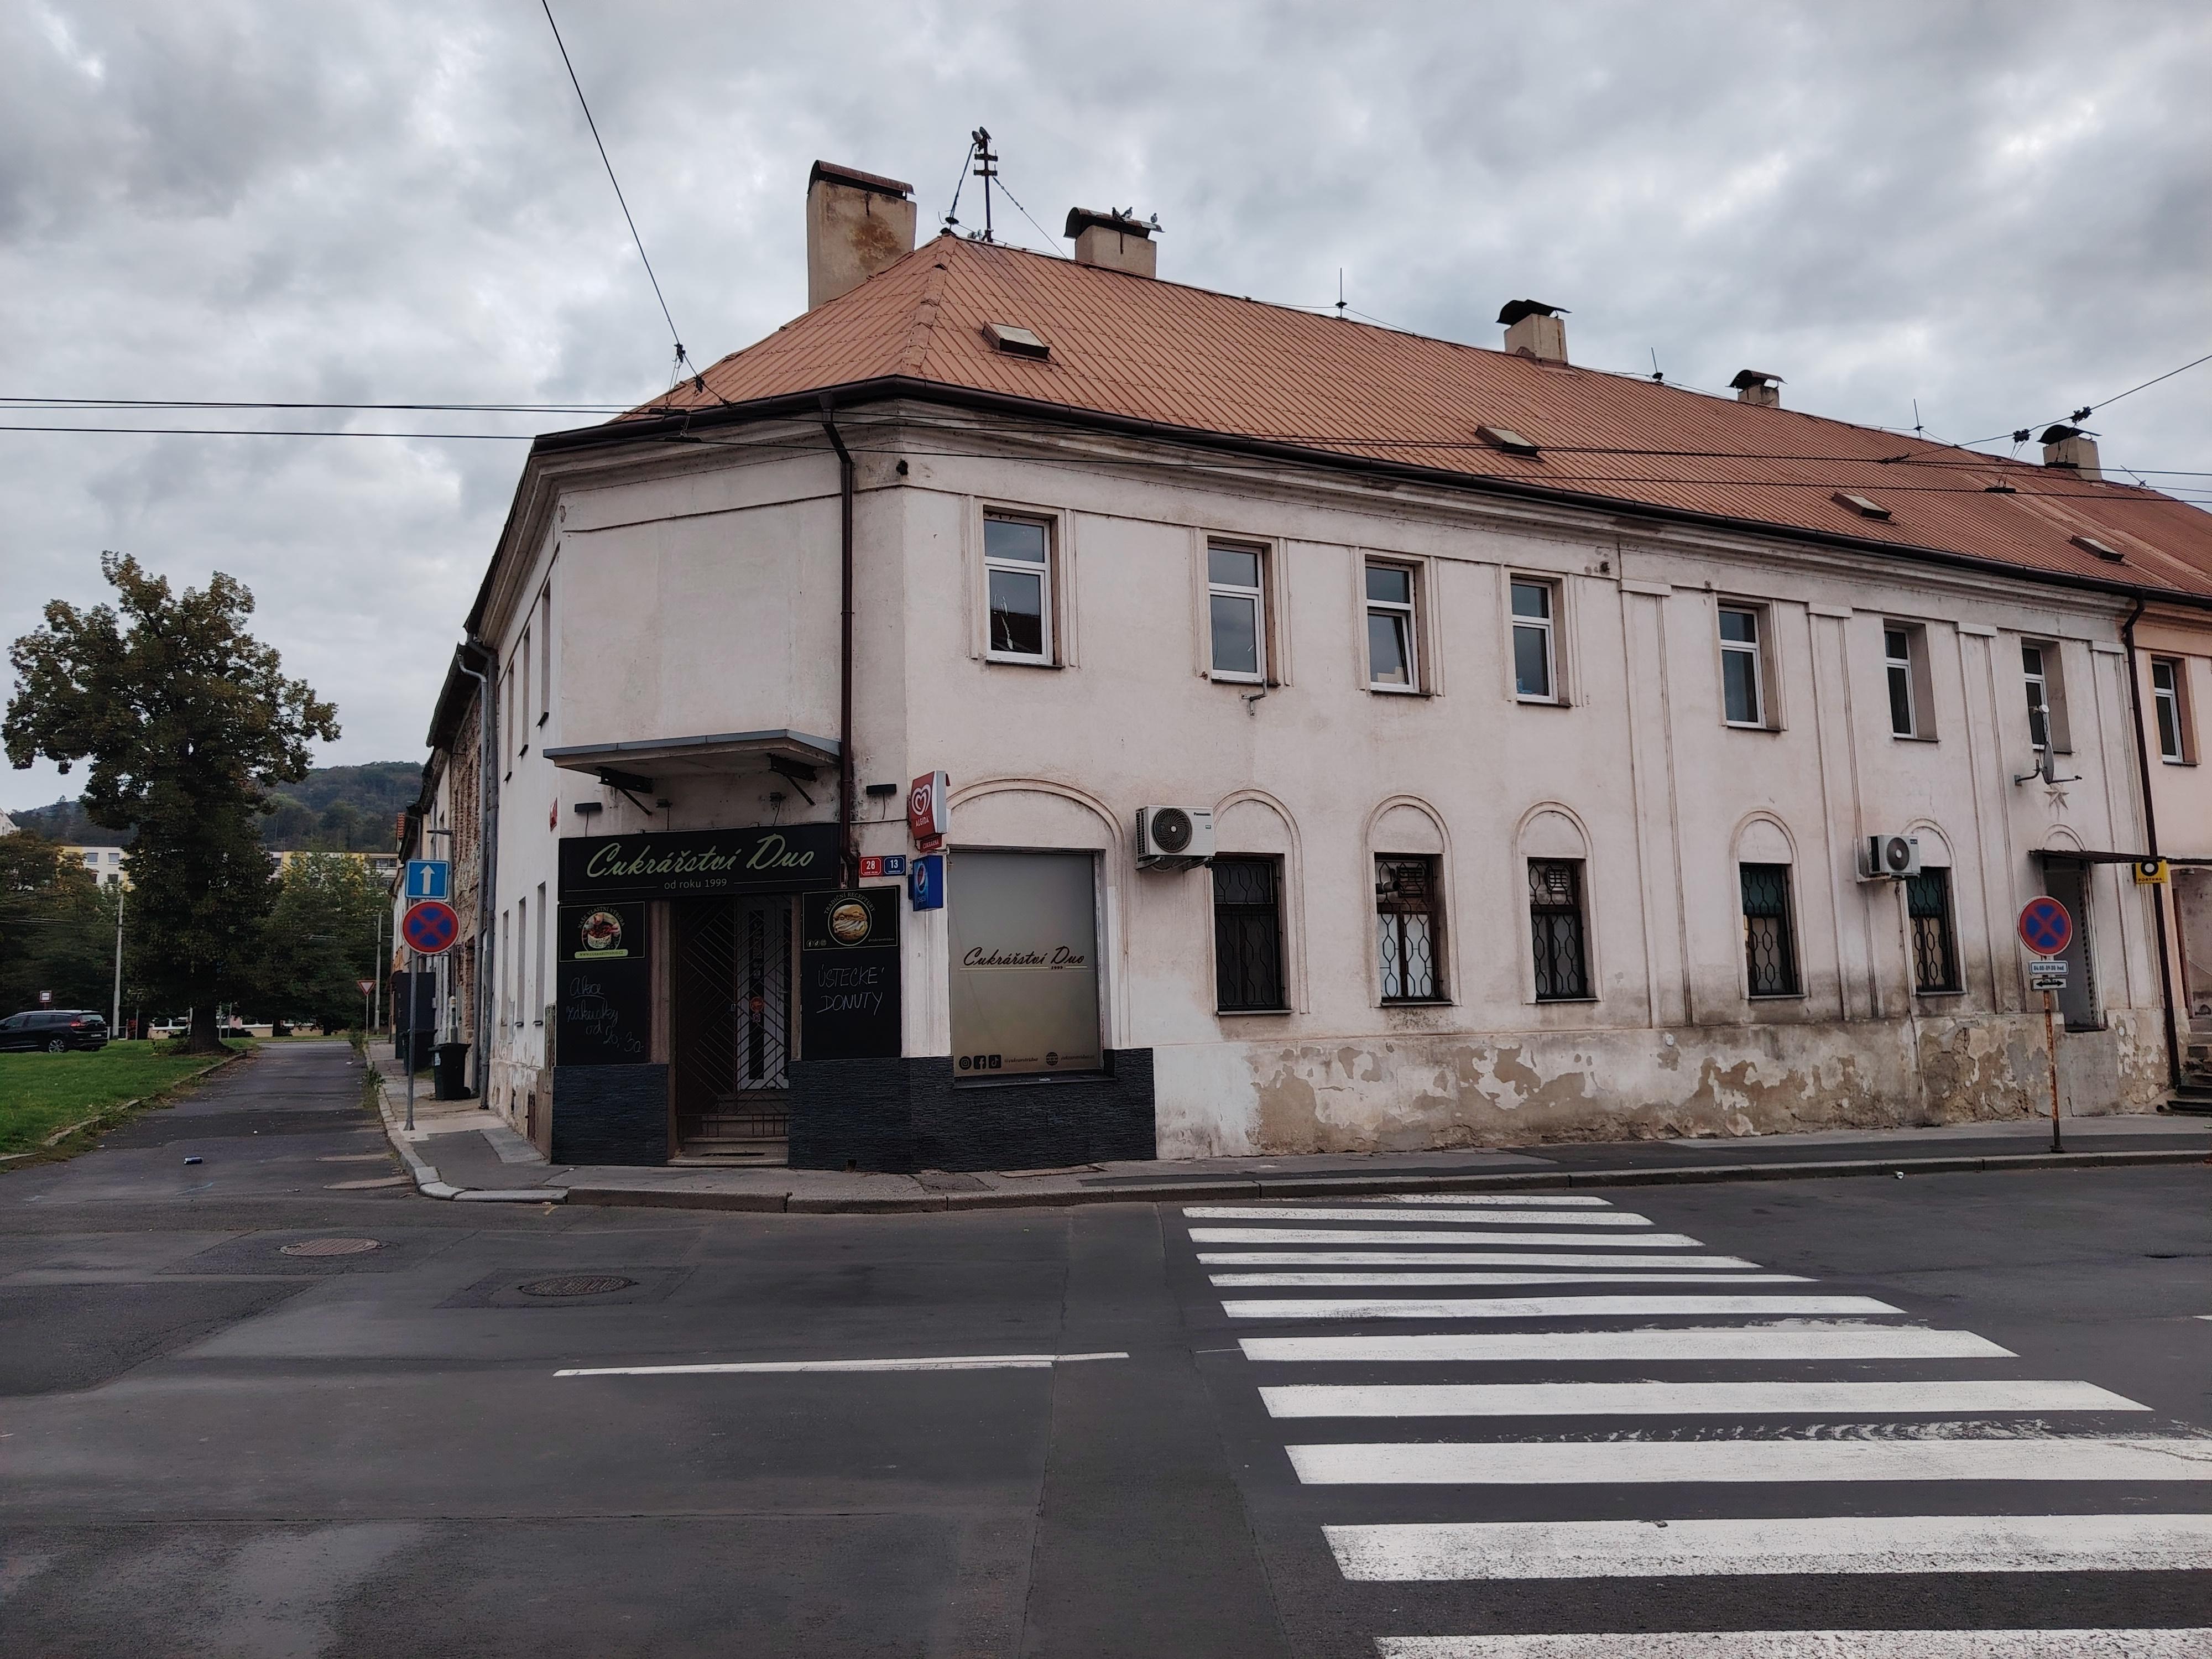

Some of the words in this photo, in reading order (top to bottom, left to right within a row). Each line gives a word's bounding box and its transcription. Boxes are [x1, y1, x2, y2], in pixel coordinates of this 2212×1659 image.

[915, 815, 930, 827] ALGIDA
[587, 842, 742, 878] Cukrářství
[747, 833, 816, 870] Duo
[890, 859, 899, 869] 13
[866, 860, 875, 870] 28
[664, 879, 677, 889] od
[680, 879, 702, 889] roku
[705, 878, 728, 888] 1999
[824, 892, 847, 915] TRADIČNÍ
[847, 892, 876, 912] RECEPTURY
[577, 914, 588, 929] NAŠE
[588, 906, 609, 916] VLASTNÍ
[610, 908, 625, 927] VÝROBA
[963, 946, 1048, 966] Cukrářství
[1050, 945, 1084, 964] Duo
[816, 992, 883, 1016] DONUTY
[586, 1020, 602, 1035] od
